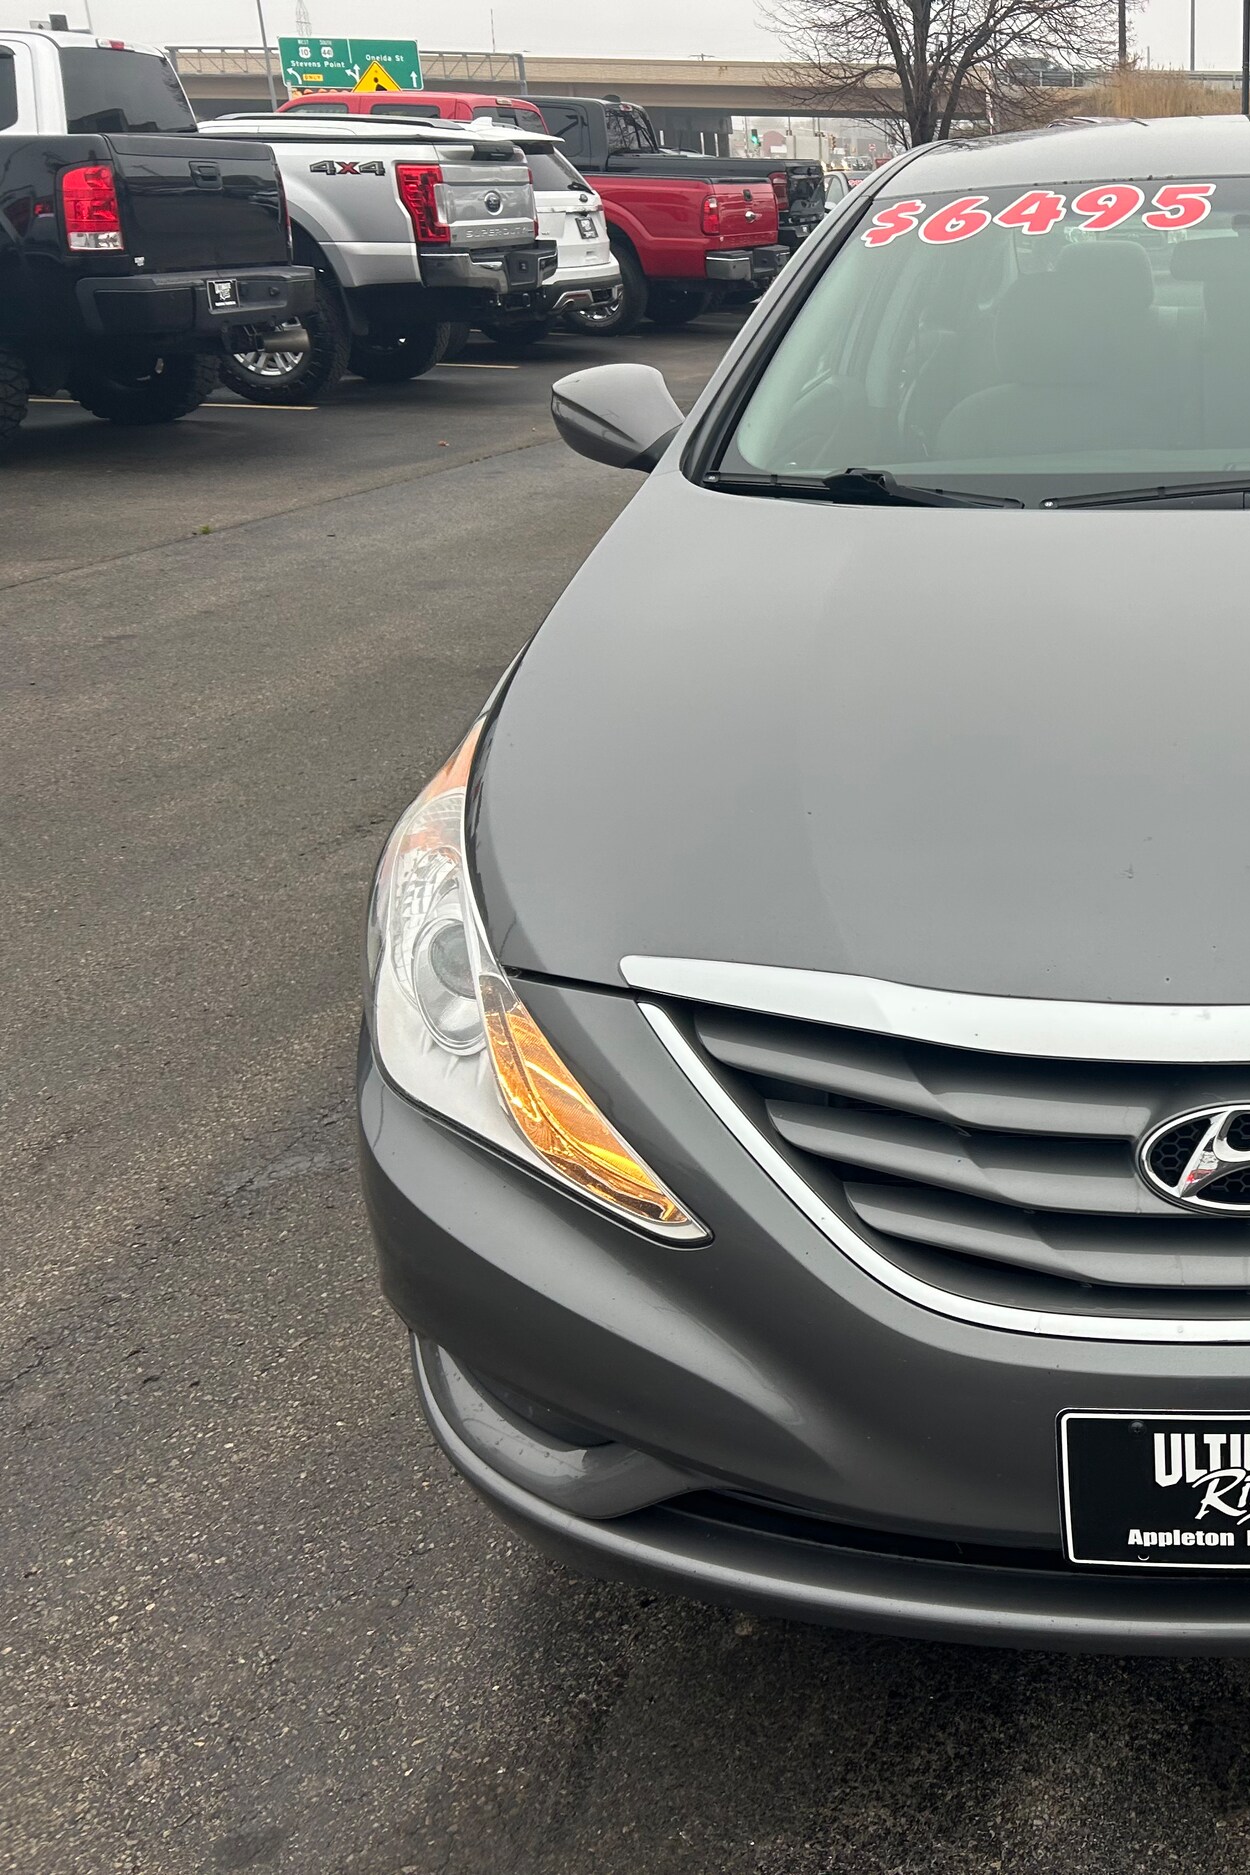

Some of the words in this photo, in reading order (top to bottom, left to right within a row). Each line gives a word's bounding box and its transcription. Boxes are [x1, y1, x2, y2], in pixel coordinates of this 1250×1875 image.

[290, 60, 321, 68] Stevens
[324, 60, 345, 68] Point
[365, 54, 392, 62] Oneida
[395, 54, 404, 62] St
[860, 183, 1216, 248] $6495
[1127, 1528, 1235, 1547] Appleton
